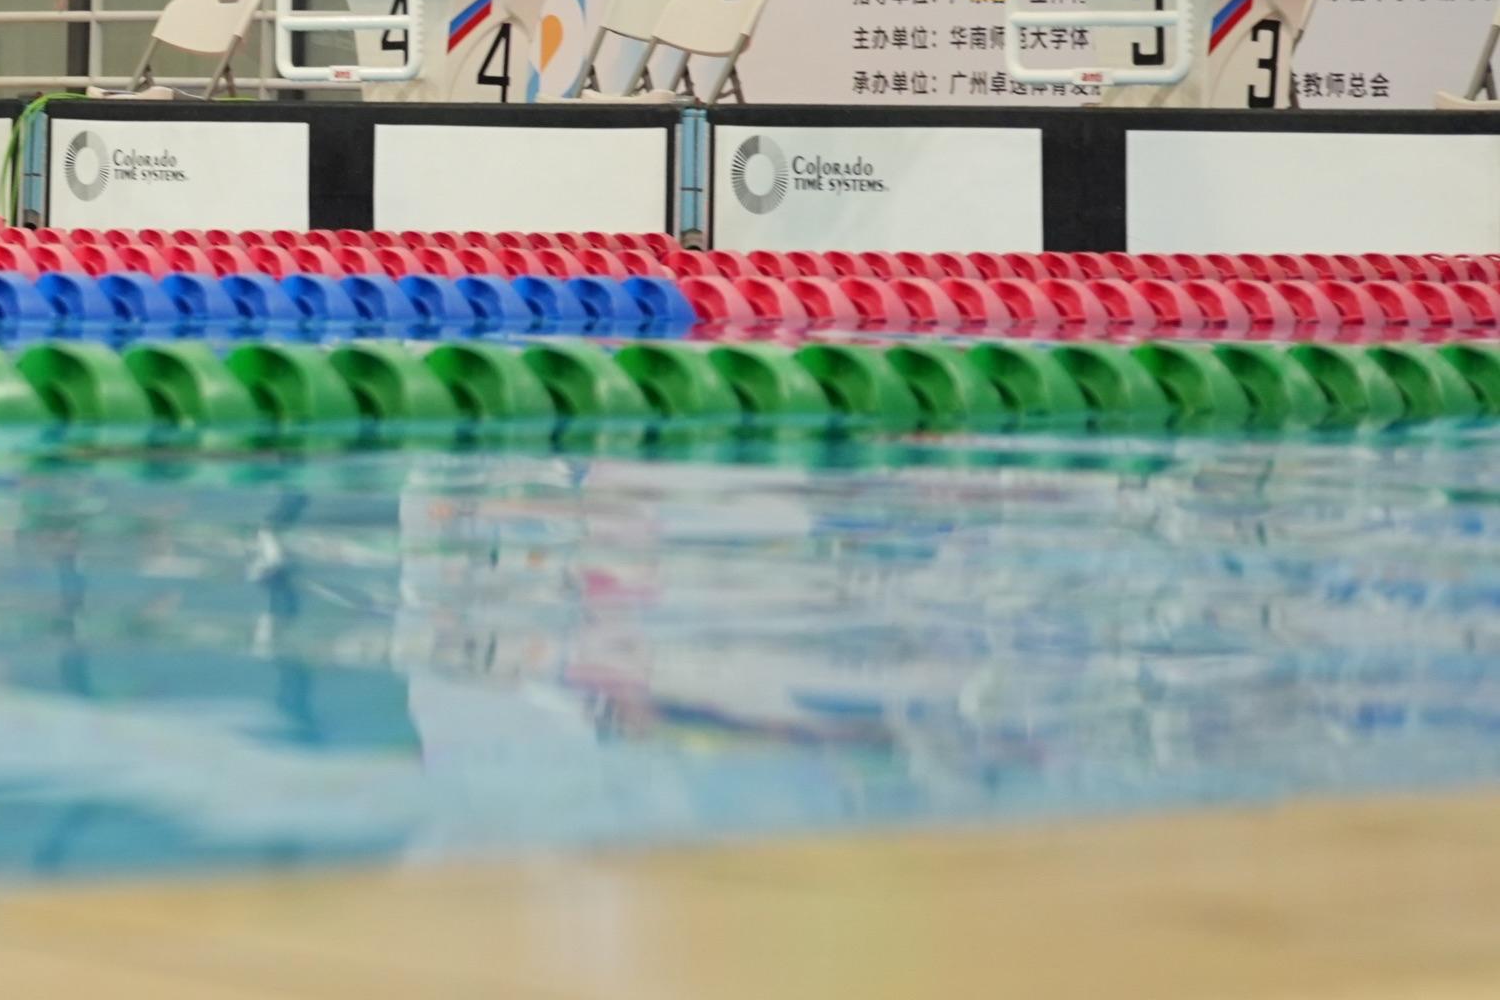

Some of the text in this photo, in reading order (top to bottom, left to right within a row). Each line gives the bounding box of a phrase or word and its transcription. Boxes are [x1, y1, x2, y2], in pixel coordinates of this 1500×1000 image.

[477, 23, 511, 102] 4
[1247, 18, 1281, 108] 3
[1292, 72, 1390, 98] 教师总会
[112, 149, 178, 168] Colorado
[792, 155, 873, 178] Colorado
[114, 168, 137, 180] TIME
[794, 178, 885, 195] TIME SYSTEMS
